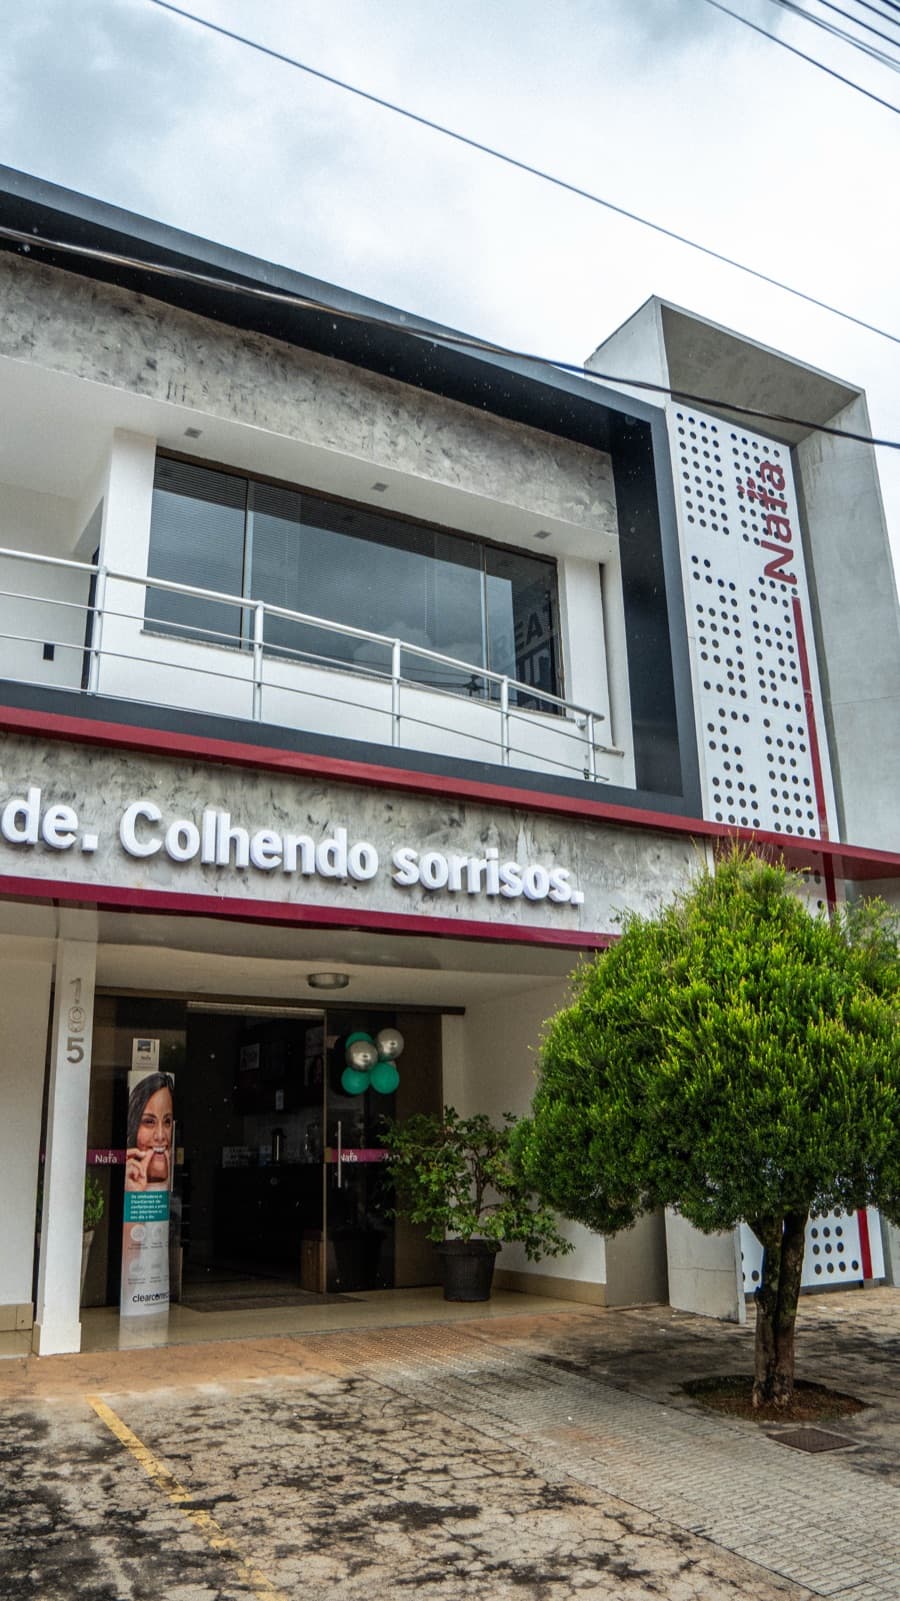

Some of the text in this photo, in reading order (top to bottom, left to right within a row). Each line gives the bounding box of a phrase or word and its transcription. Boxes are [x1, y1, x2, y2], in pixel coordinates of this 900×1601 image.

[0, 787, 585, 905] de. Colhendo sorrisos.
